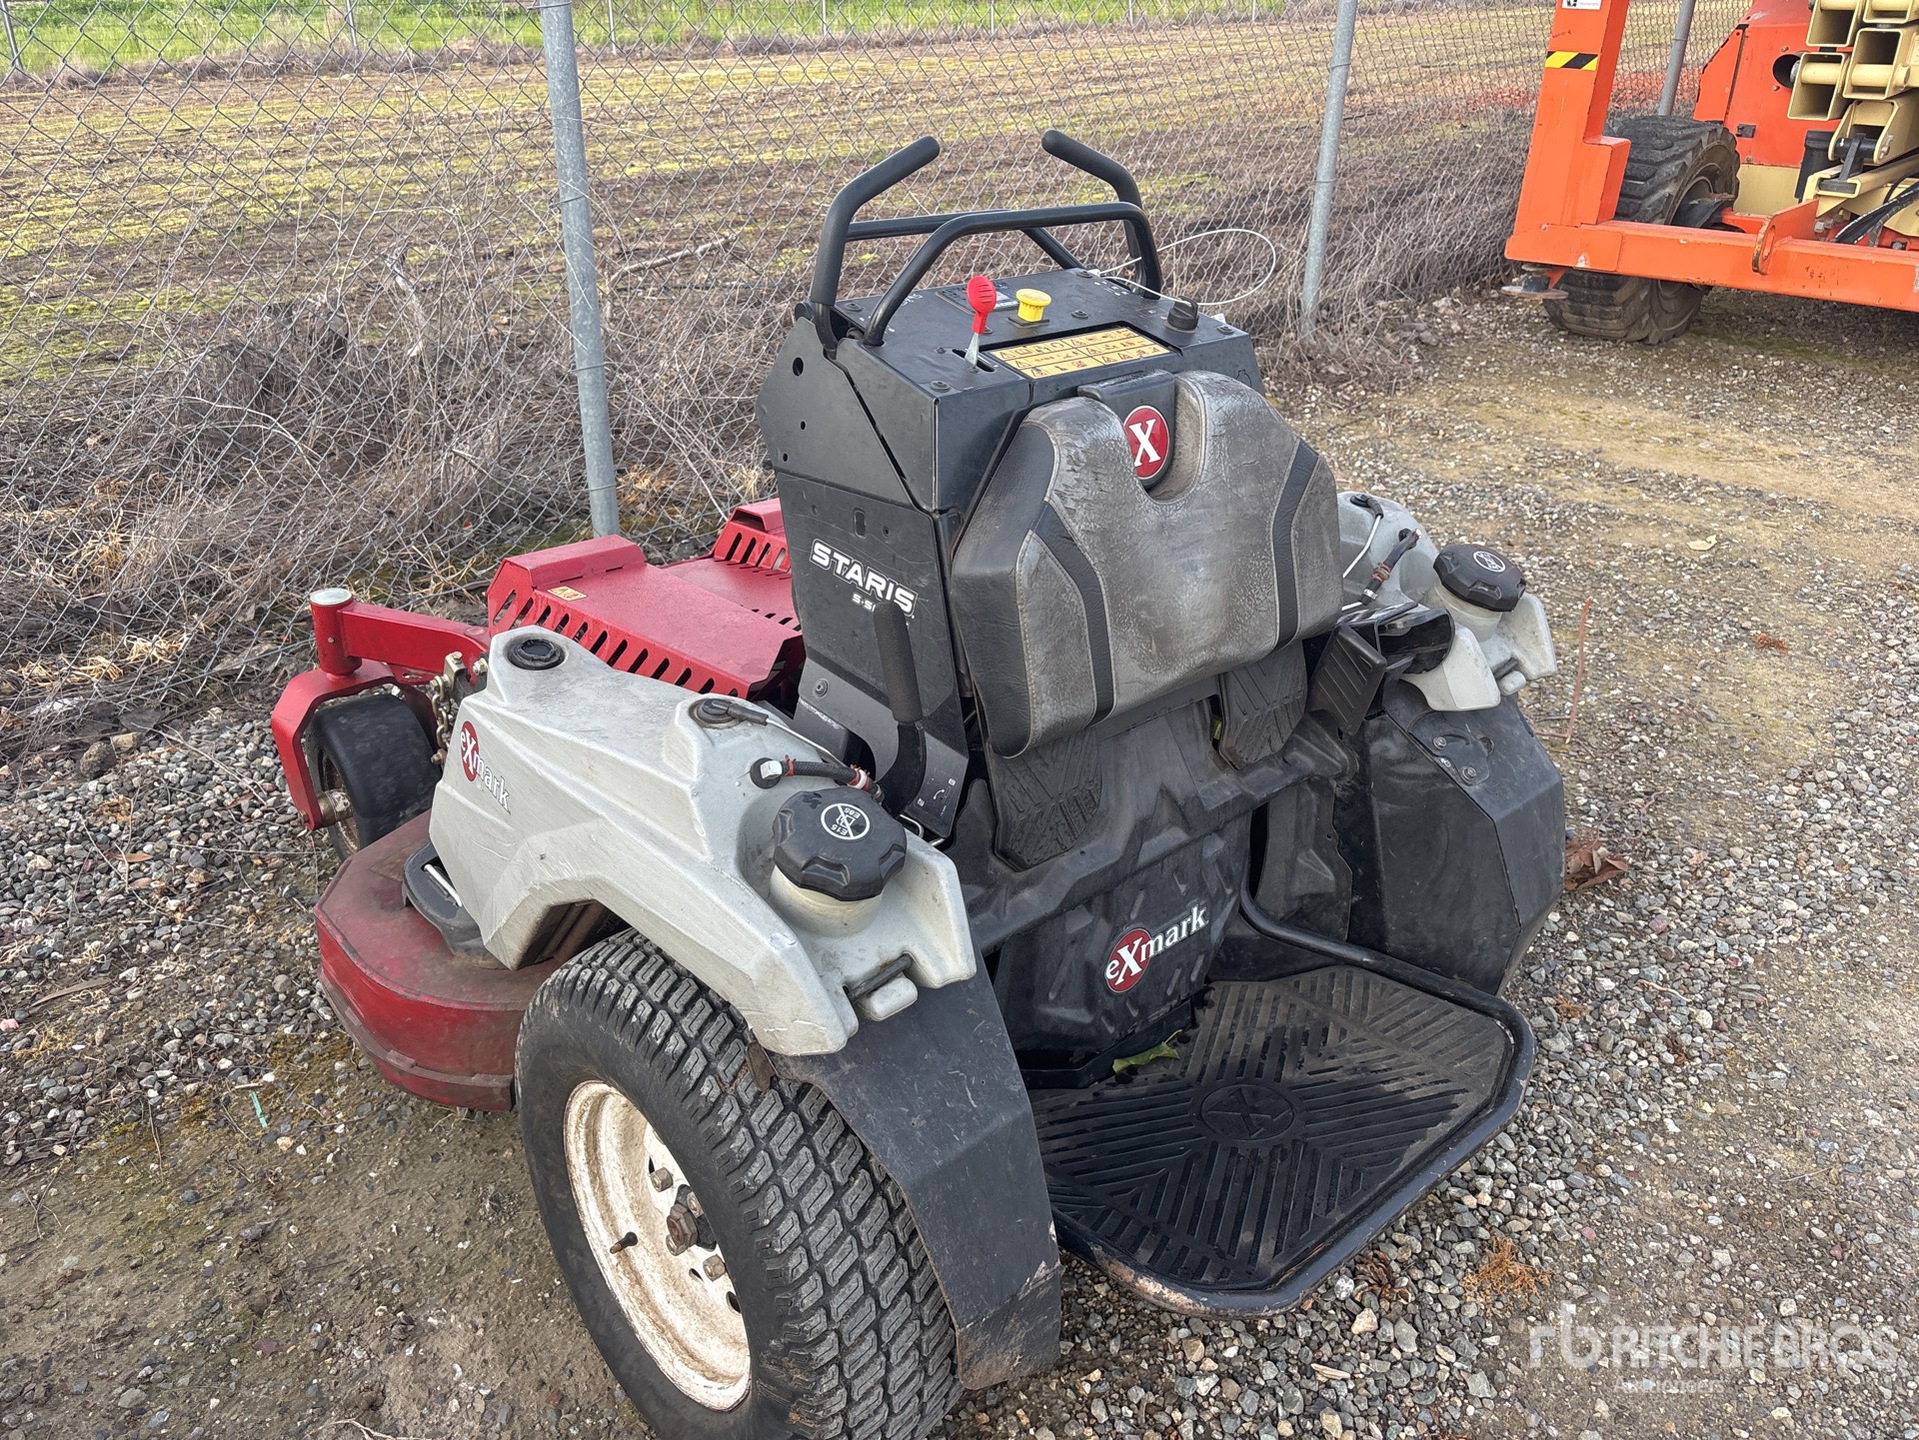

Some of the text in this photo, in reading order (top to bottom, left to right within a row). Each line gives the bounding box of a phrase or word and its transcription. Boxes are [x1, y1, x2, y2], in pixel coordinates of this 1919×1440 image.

[1128, 418, 1161, 467] X
[811, 541, 915, 613] STARIS
[830, 823, 849, 836] E15
